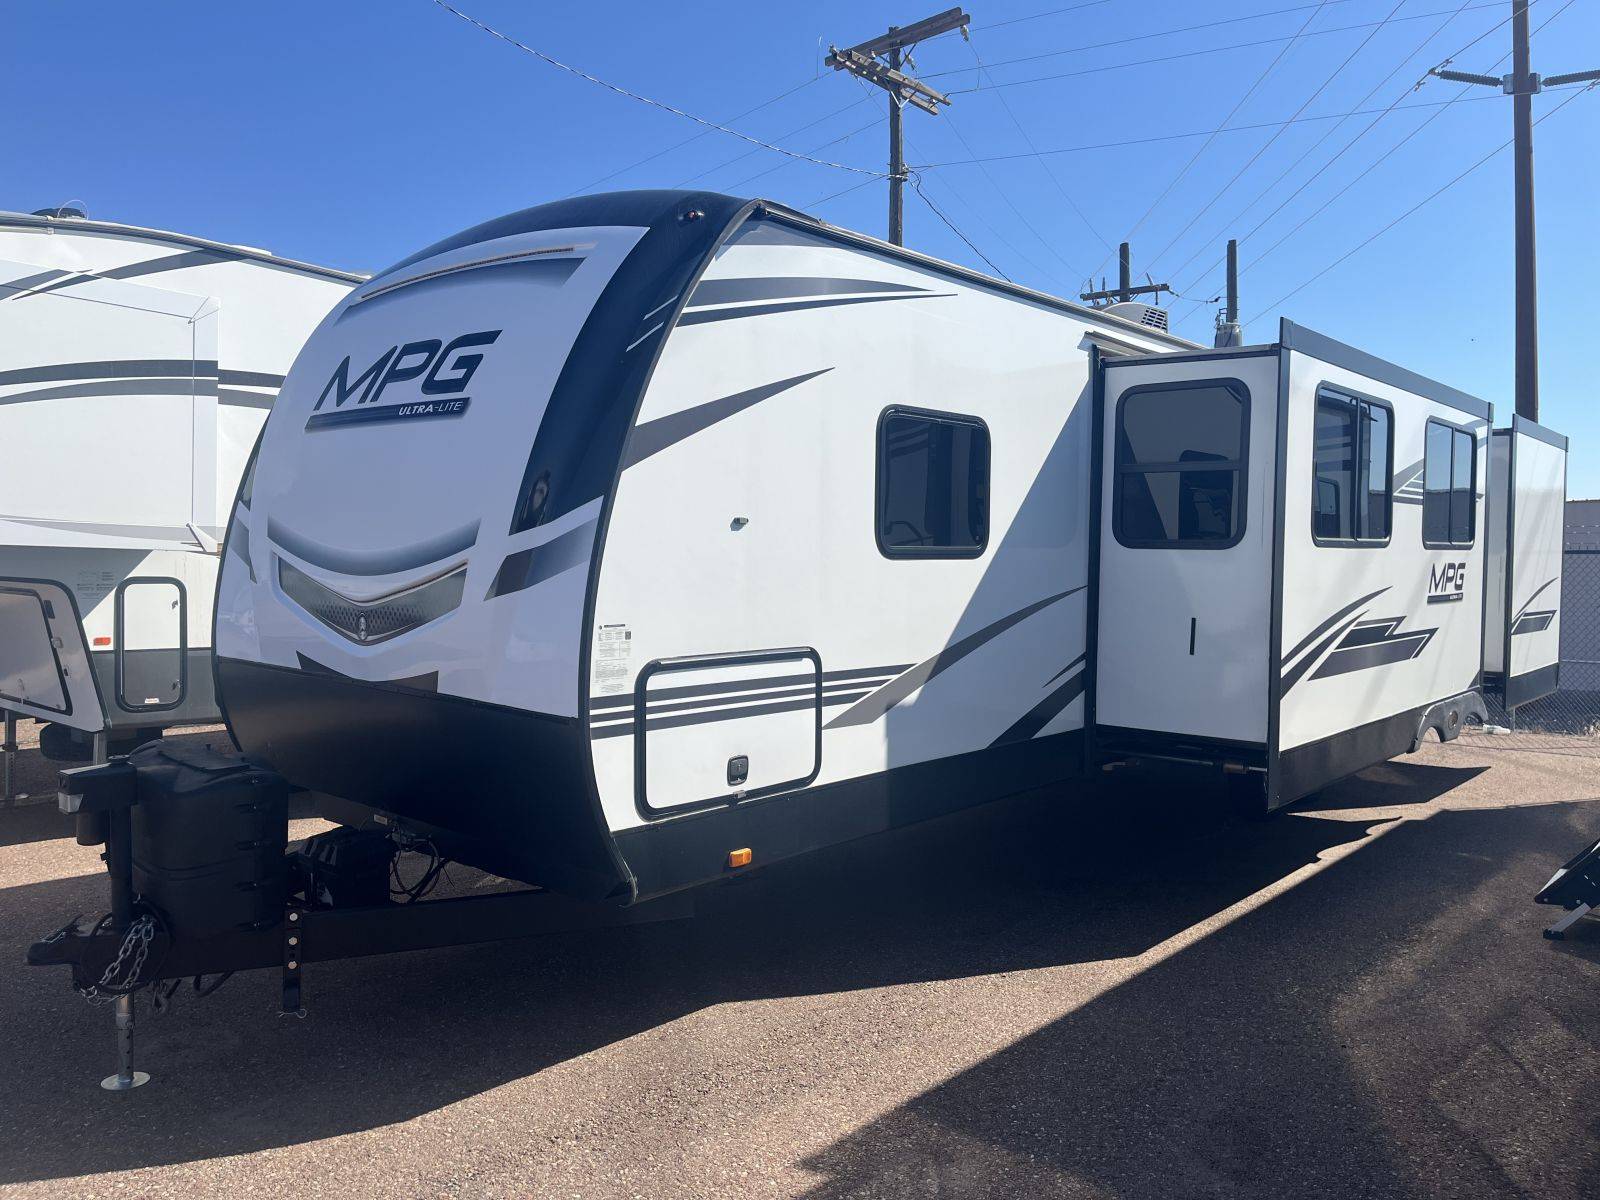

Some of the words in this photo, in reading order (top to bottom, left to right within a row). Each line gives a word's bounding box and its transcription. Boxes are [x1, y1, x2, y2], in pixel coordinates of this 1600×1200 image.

[313, 329, 503, 411] MPG
[399, 401, 463, 415] ULTRA-LITE
[1429, 562, 1466, 593] MPG
